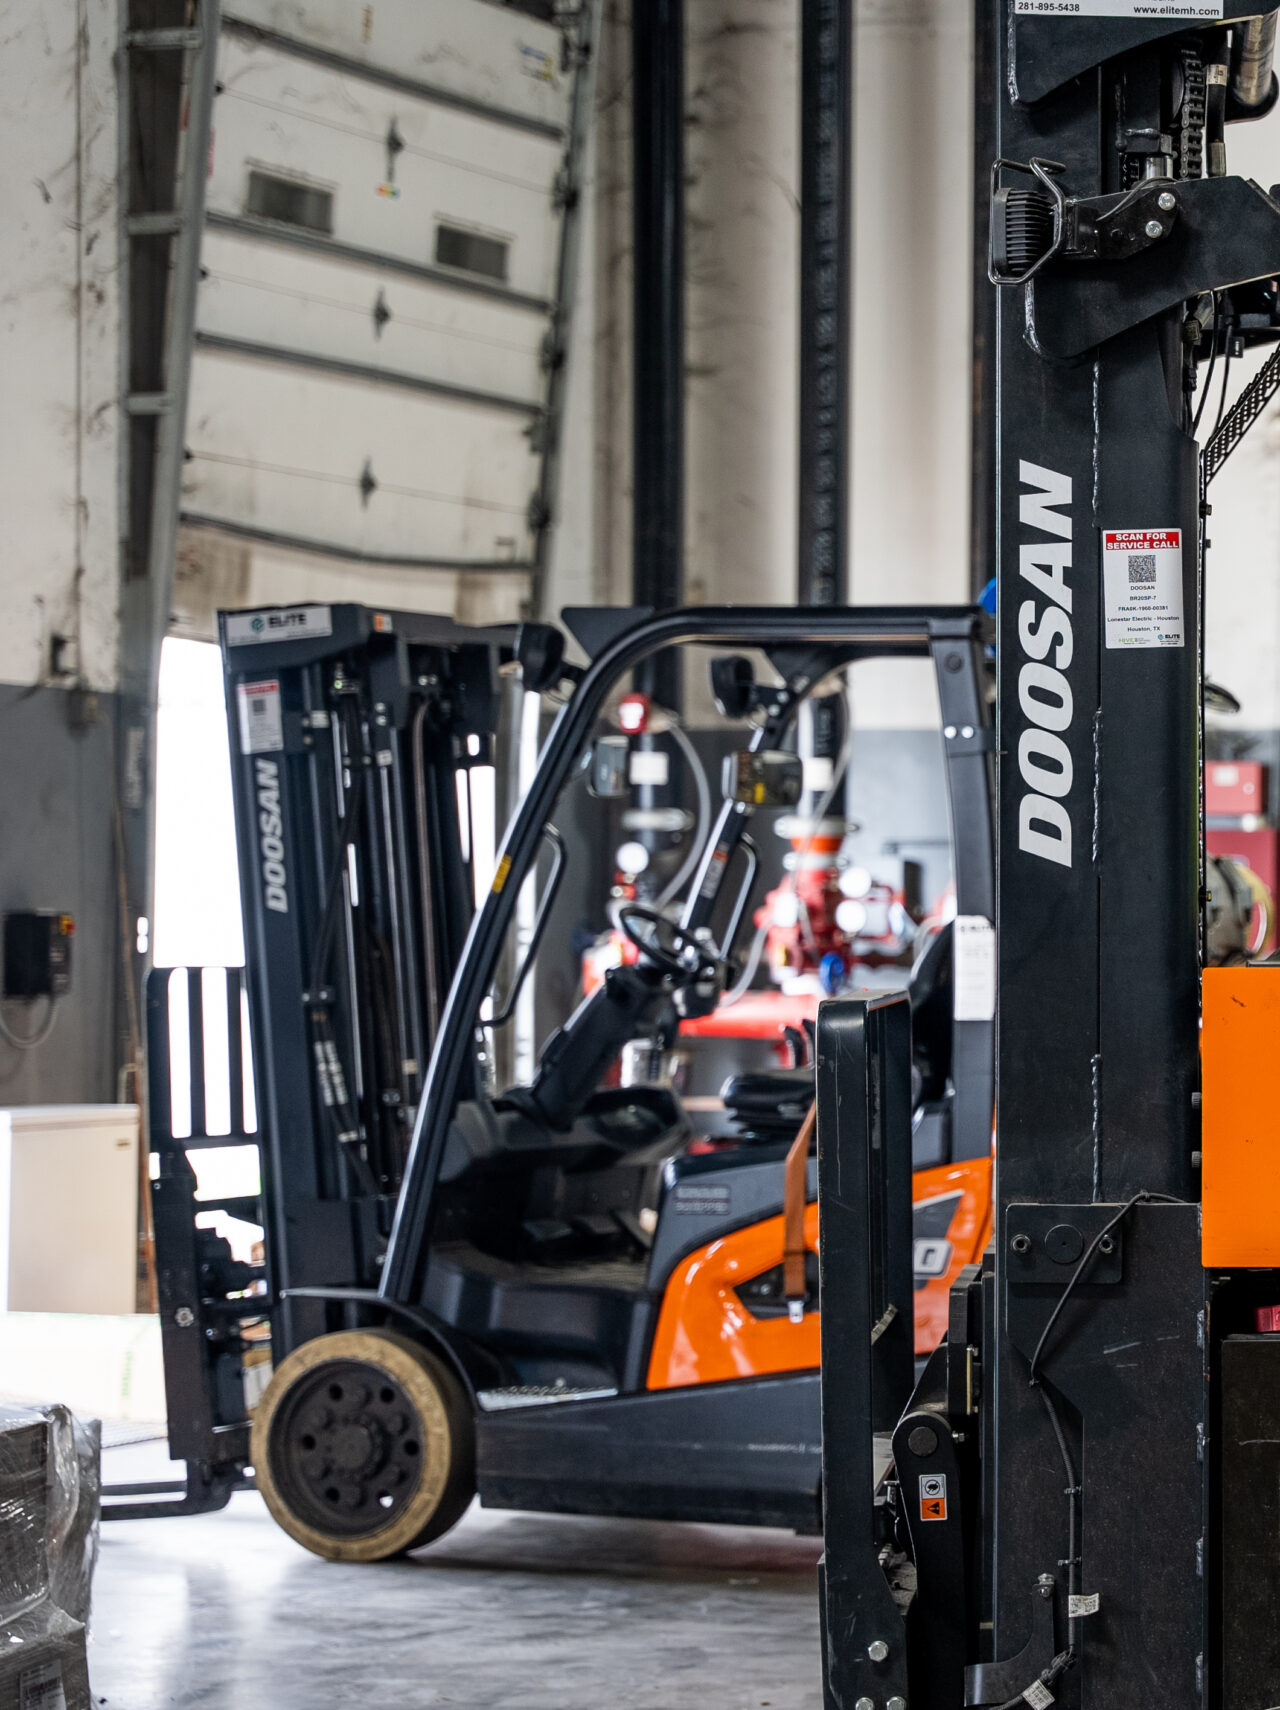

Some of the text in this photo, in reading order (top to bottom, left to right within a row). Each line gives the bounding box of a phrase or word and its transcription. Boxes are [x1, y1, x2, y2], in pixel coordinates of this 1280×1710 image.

[1018, 2, 1220, 16] 281-895-5438 www.elitemh.com
[1116, 532, 1167, 541] SCAN FOR
[1107, 541, 1178, 550] SERVICE CALL
[268, 613, 307, 628] ELITE
[1018, 459, 1074, 868] DOOSAN
[255, 758, 288, 914] DOOSAN
